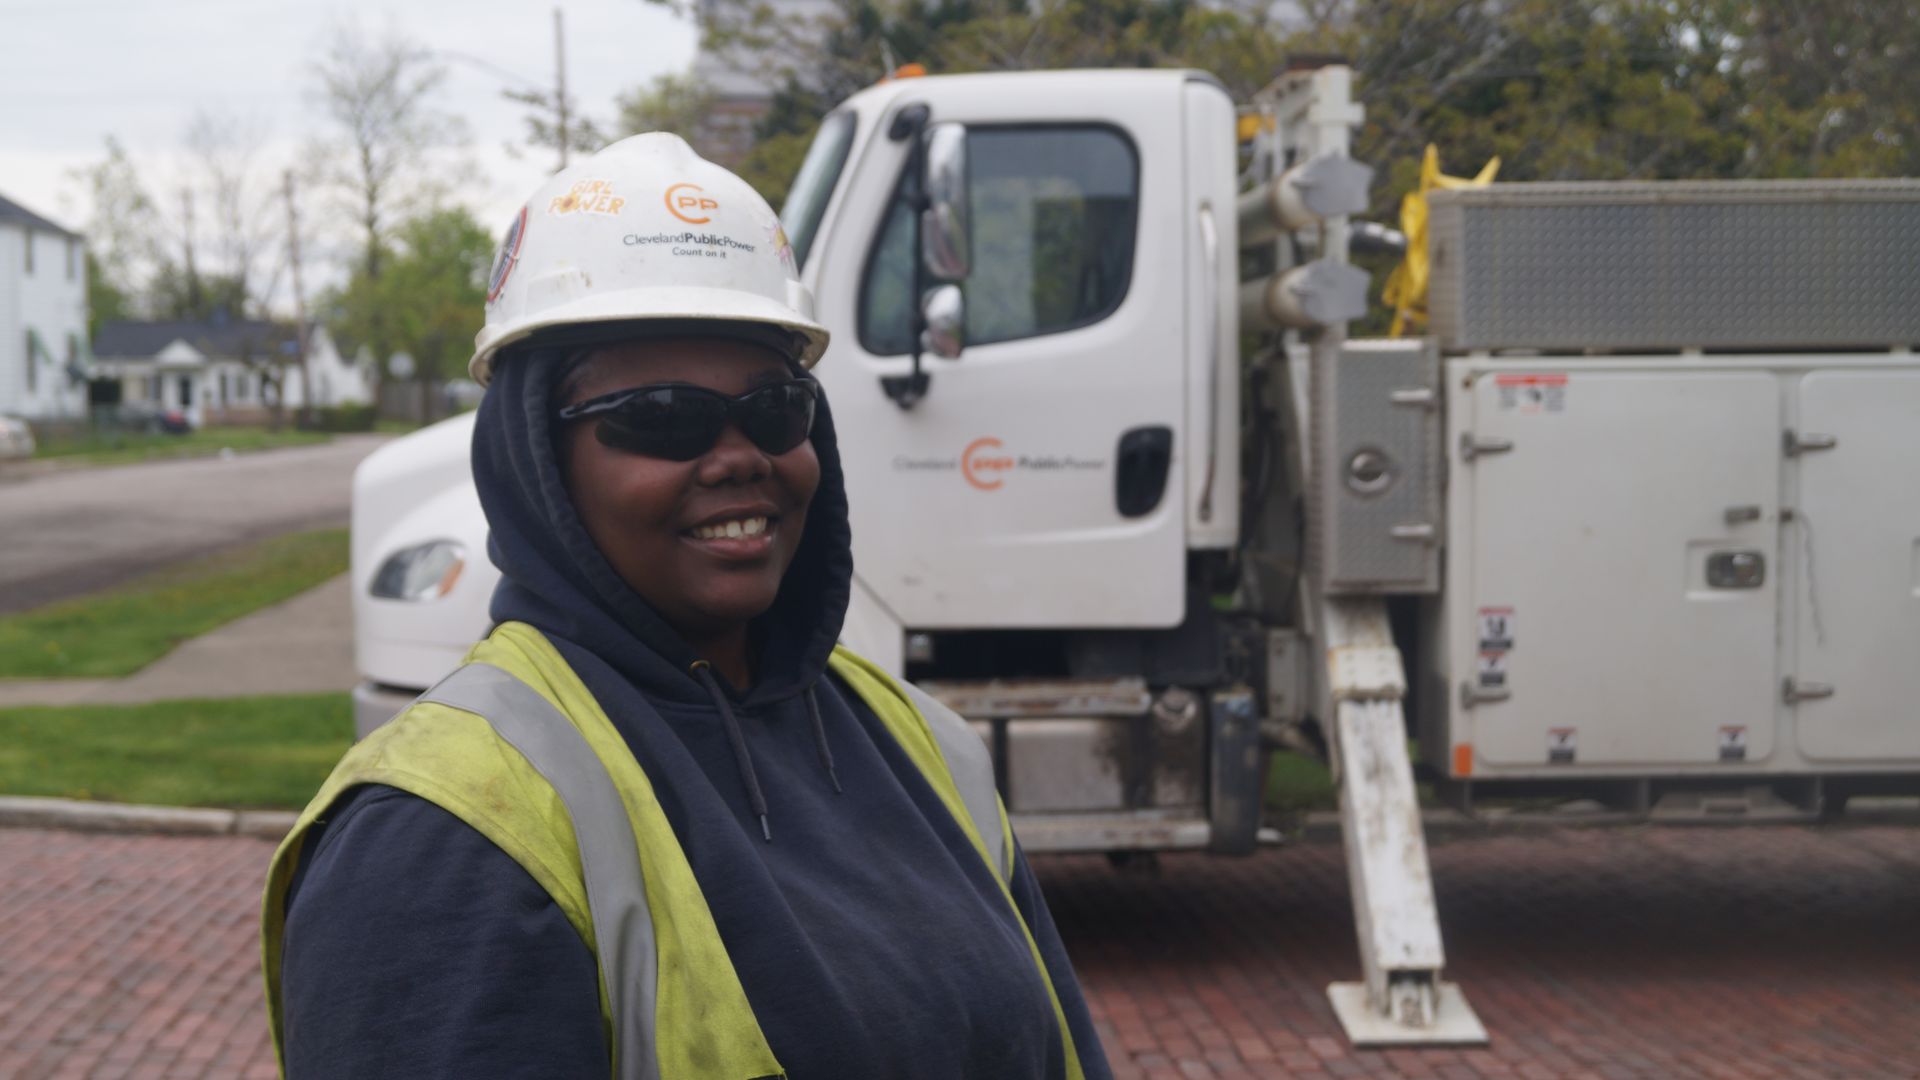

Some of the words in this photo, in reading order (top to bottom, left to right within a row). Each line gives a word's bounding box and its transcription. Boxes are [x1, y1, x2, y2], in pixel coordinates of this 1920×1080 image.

[571, 179, 613, 195] GIRL
[547, 194, 625, 215] POWER
[672, 247, 703, 258] Count
[705, 251, 718, 259] on
[720, 250, 728, 260] it
